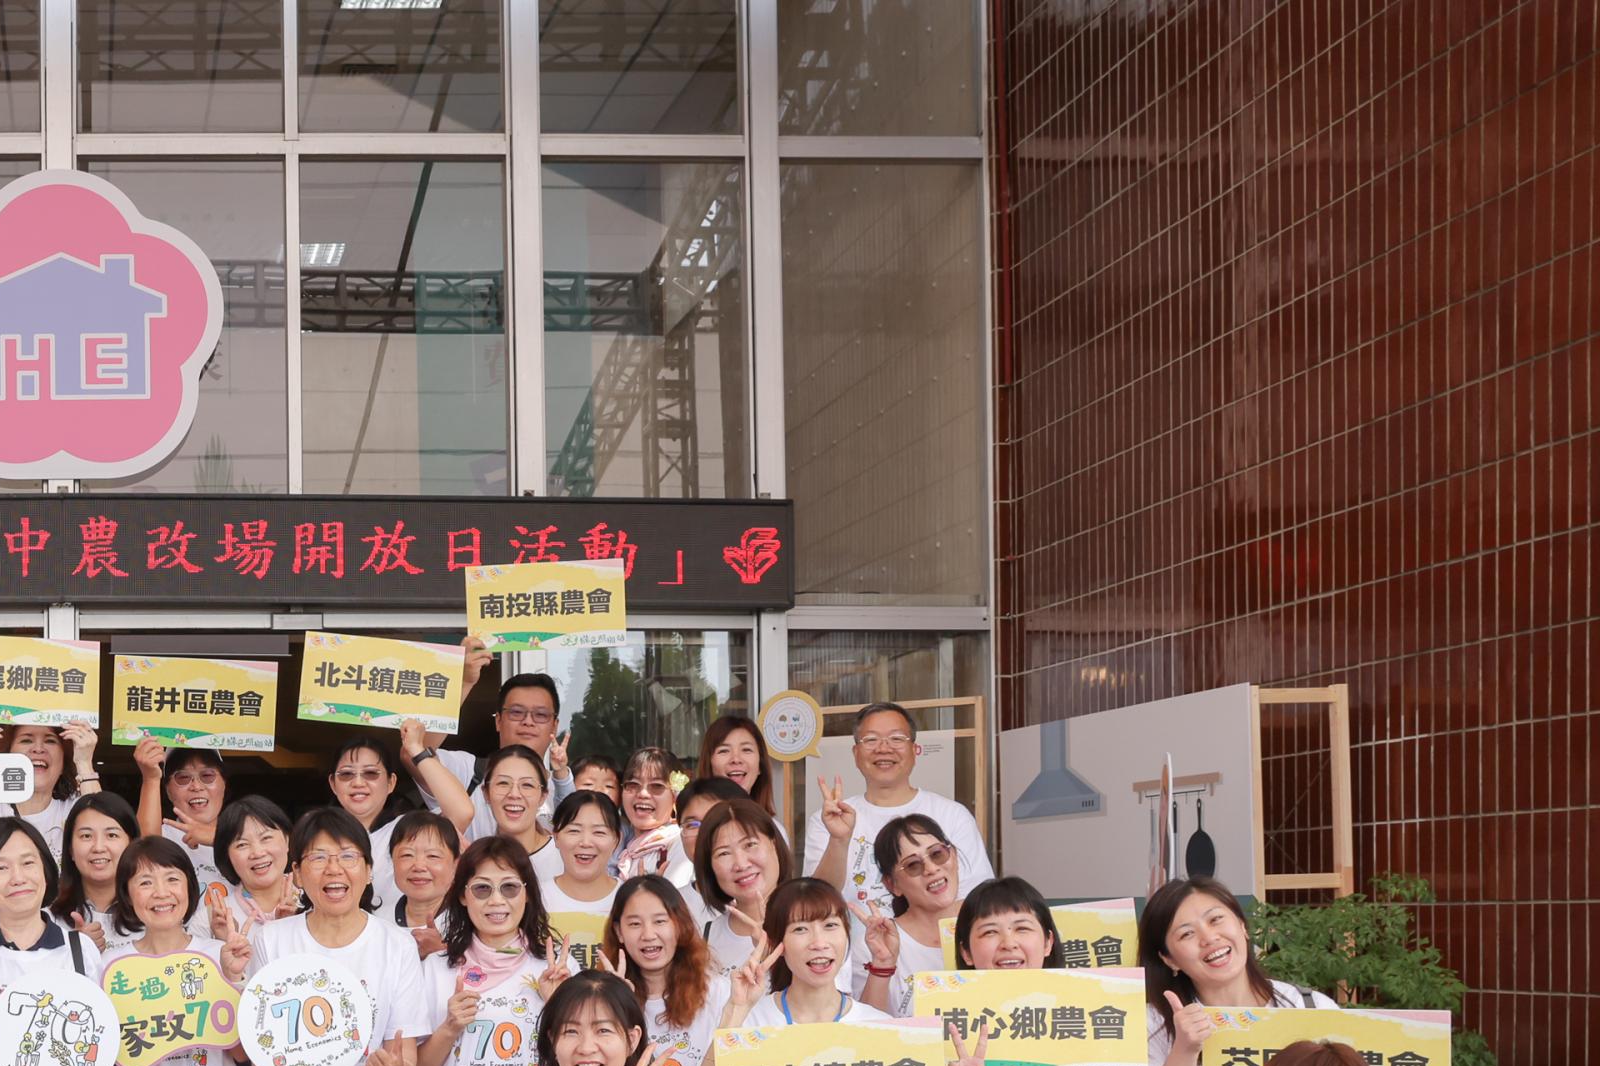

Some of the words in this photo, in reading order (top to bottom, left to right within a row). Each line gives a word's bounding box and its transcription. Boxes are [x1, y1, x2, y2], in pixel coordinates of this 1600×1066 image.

[0, 333, 128, 401] HE
[479, 588, 612, 619] 南投縣農會
[314, 661, 450, 700] 北斗鎮農會
[127, 685, 264, 717] 龍井區農會
[110, 971, 169, 1000] 走過
[120, 1000, 235, 1058] 家政70
[284, 1045, 303, 1054] Home
[306, 1035, 342, 1050] Economics
